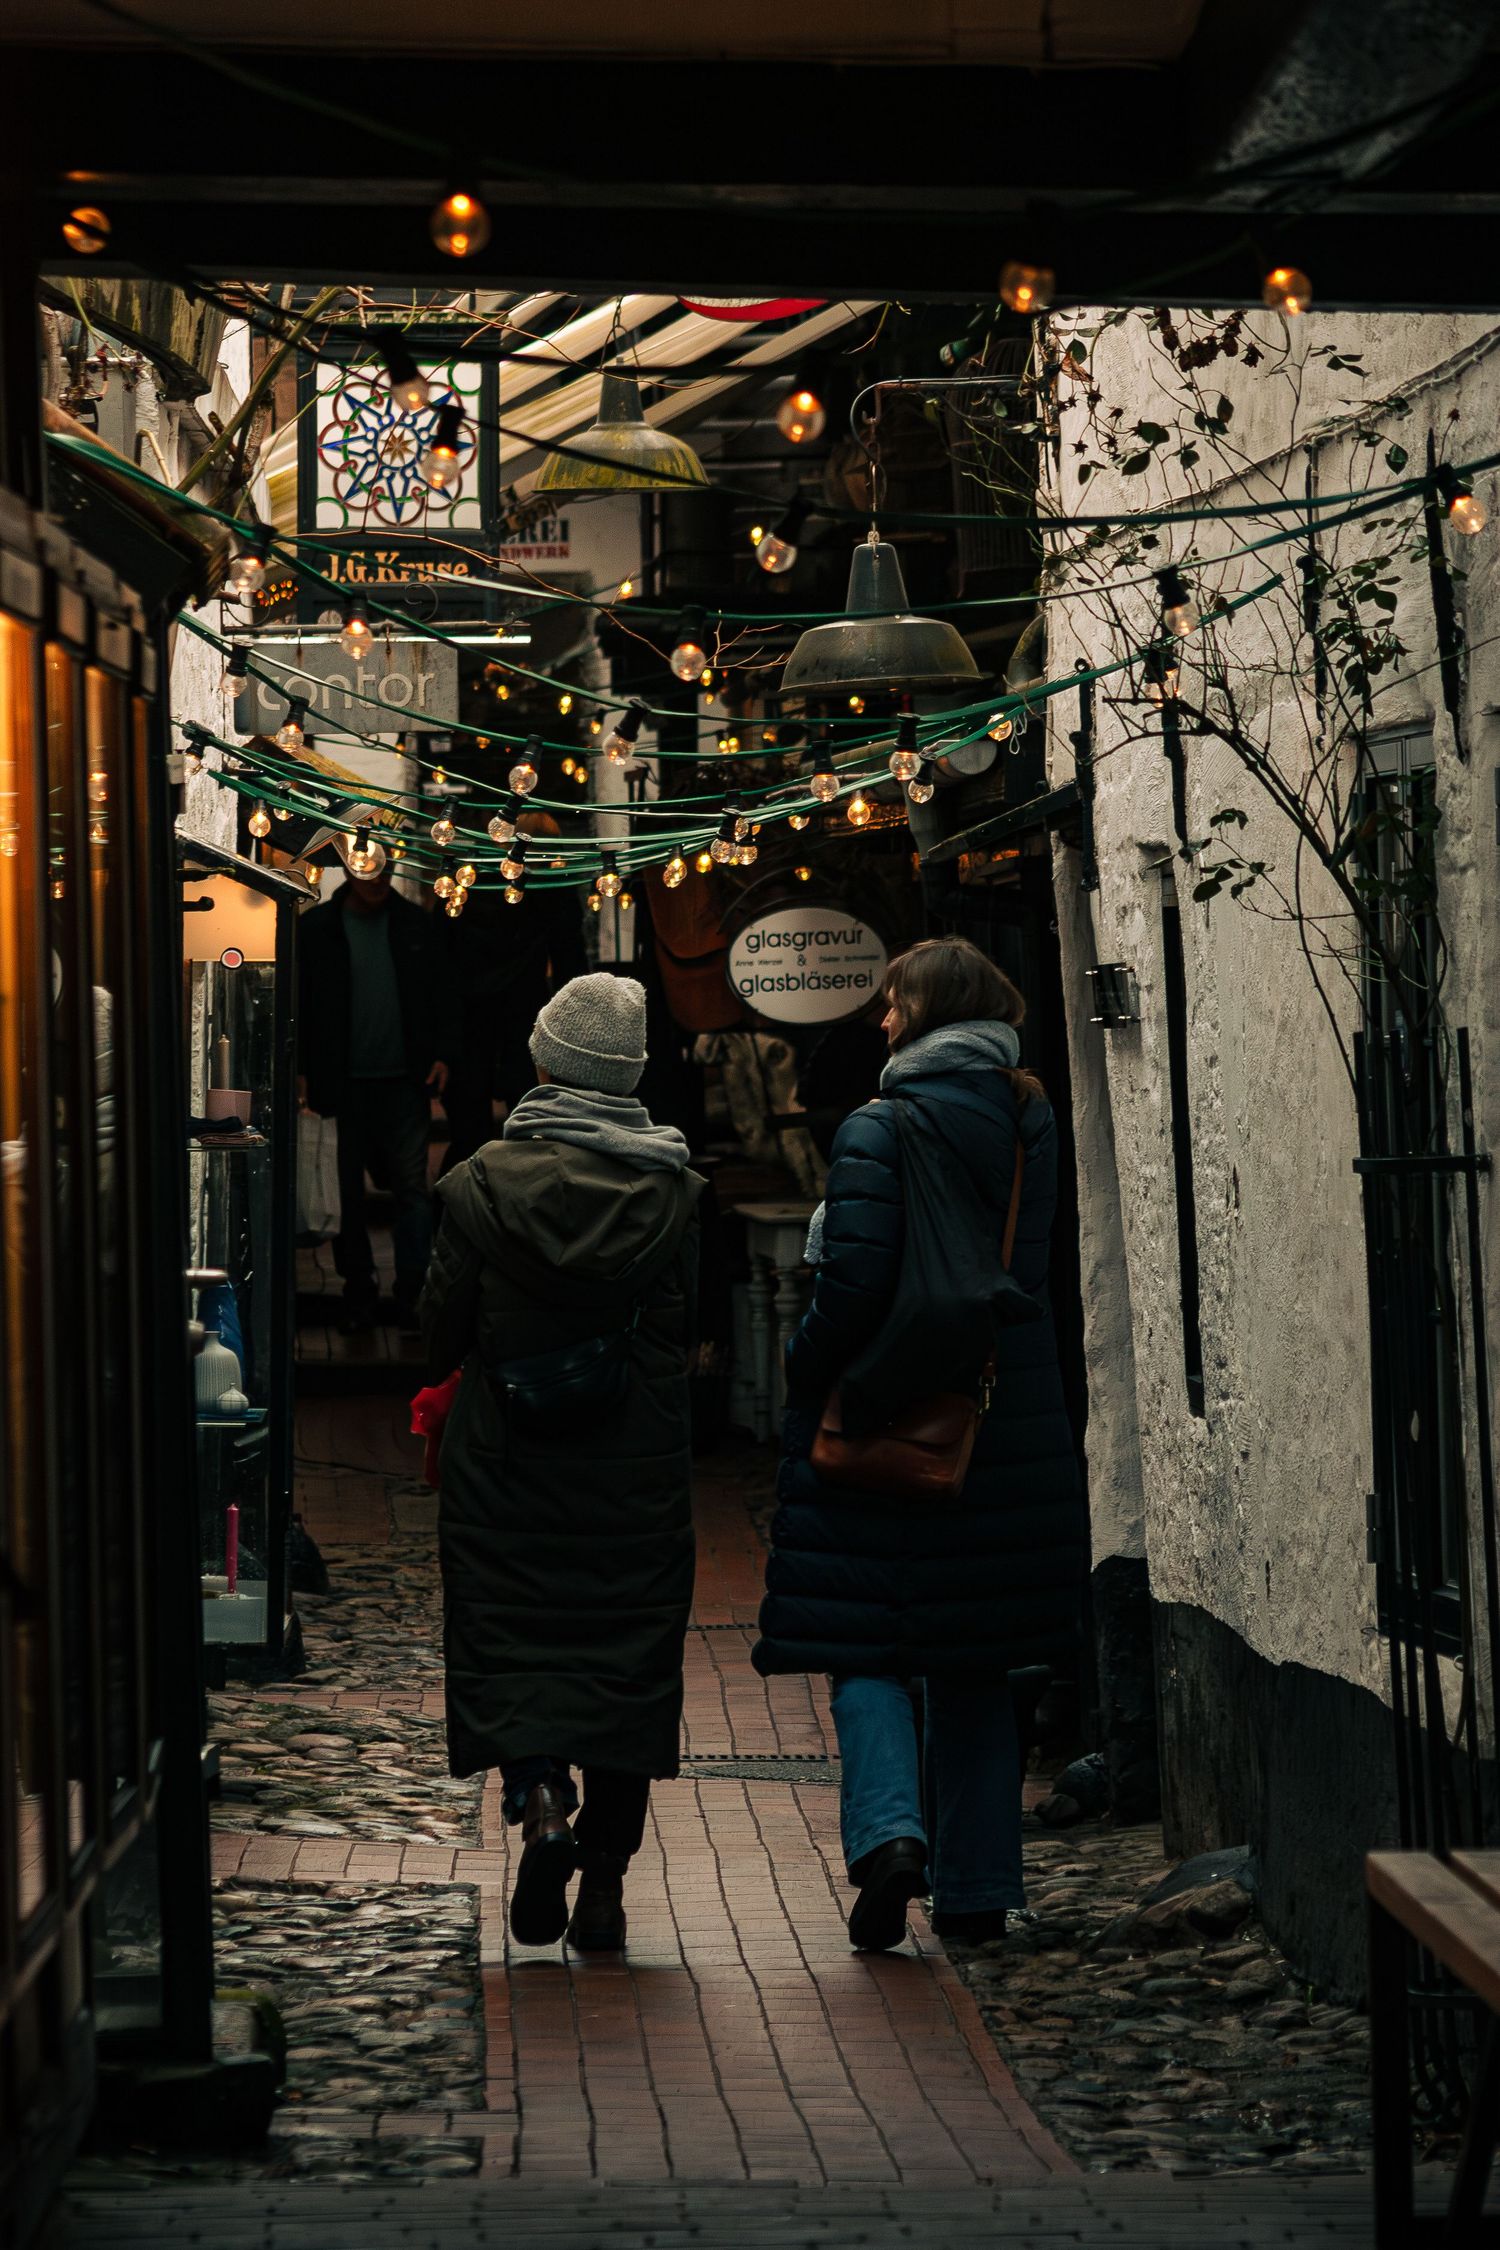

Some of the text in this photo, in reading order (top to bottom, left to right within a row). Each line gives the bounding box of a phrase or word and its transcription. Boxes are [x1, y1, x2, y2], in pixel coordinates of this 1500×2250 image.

[256, 665, 435, 711] contor
[745, 929, 863, 954] glasgravur
[739, 968, 873, 998] glasbläserei
